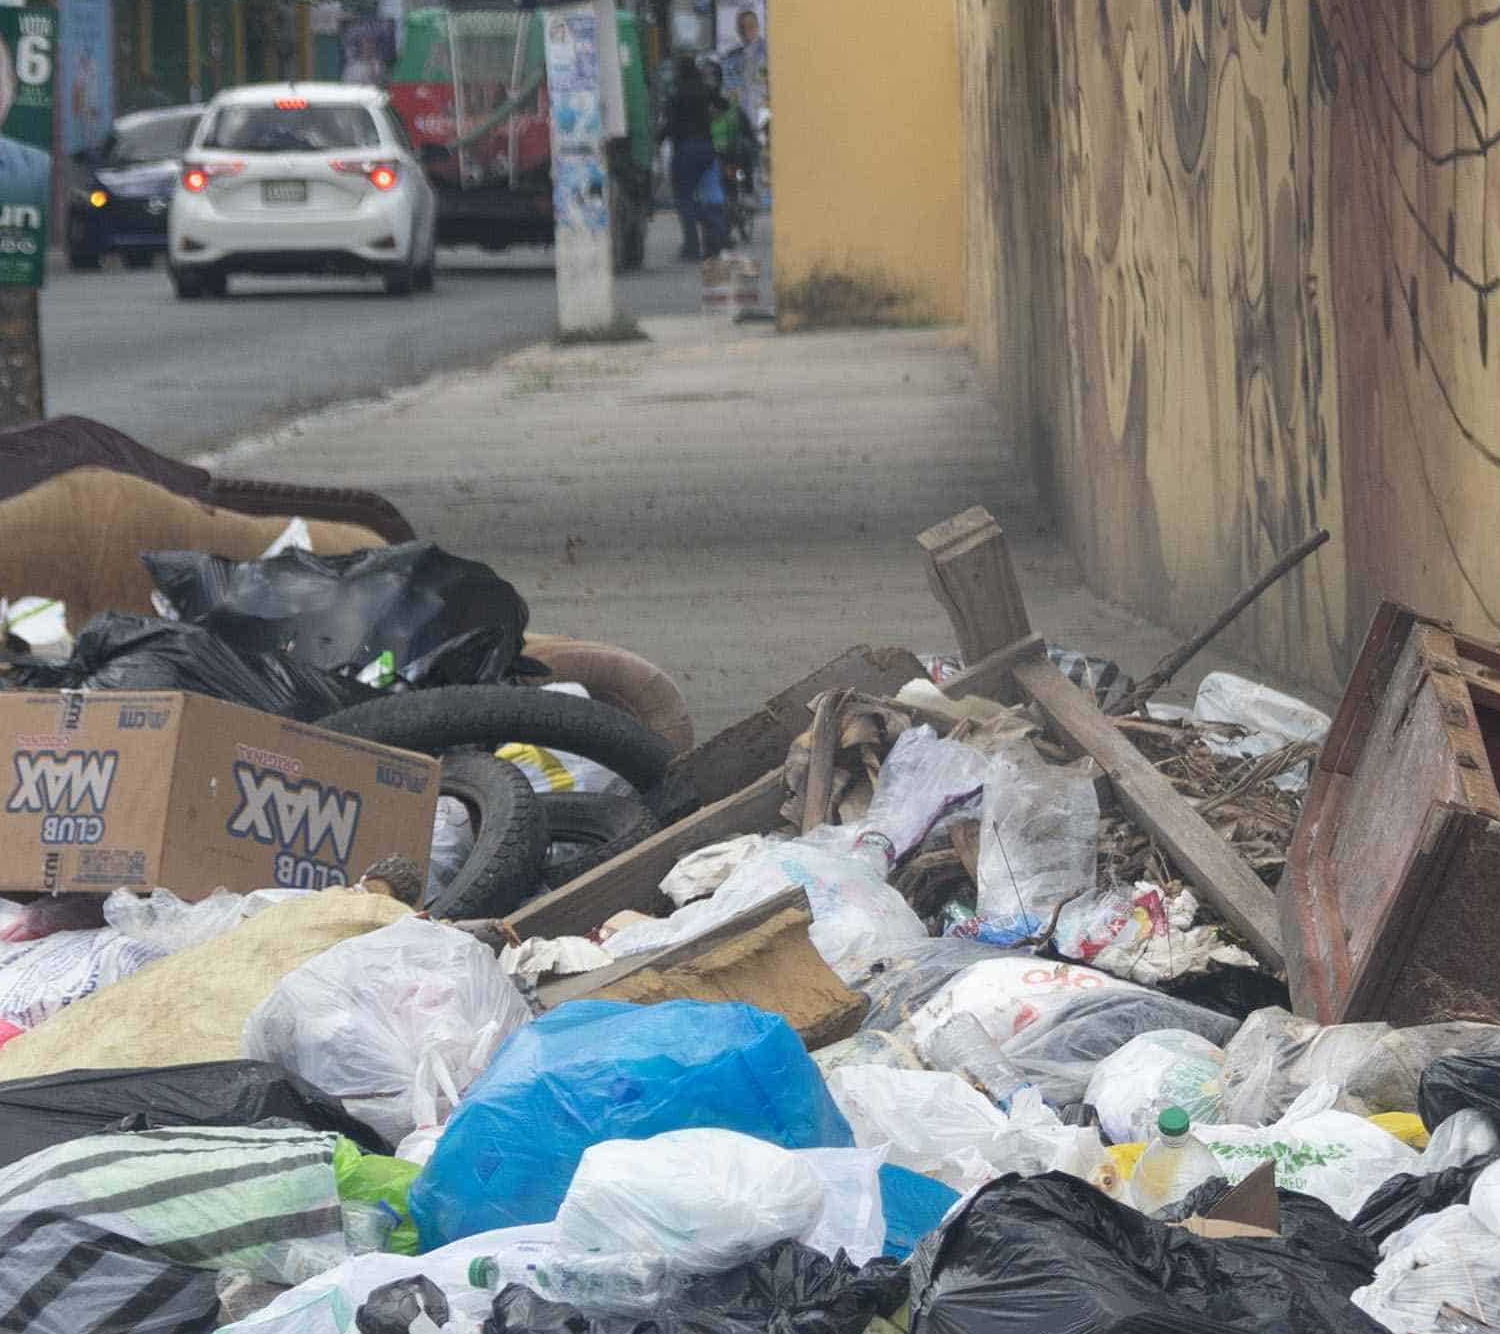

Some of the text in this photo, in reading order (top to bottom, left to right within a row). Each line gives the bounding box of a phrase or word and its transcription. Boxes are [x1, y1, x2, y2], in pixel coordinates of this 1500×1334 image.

[16, 36, 51, 85] 6
[7, 749, 120, 814] MAX
[41, 815, 106, 845] CLUB
[226, 759, 363, 868] MAX
